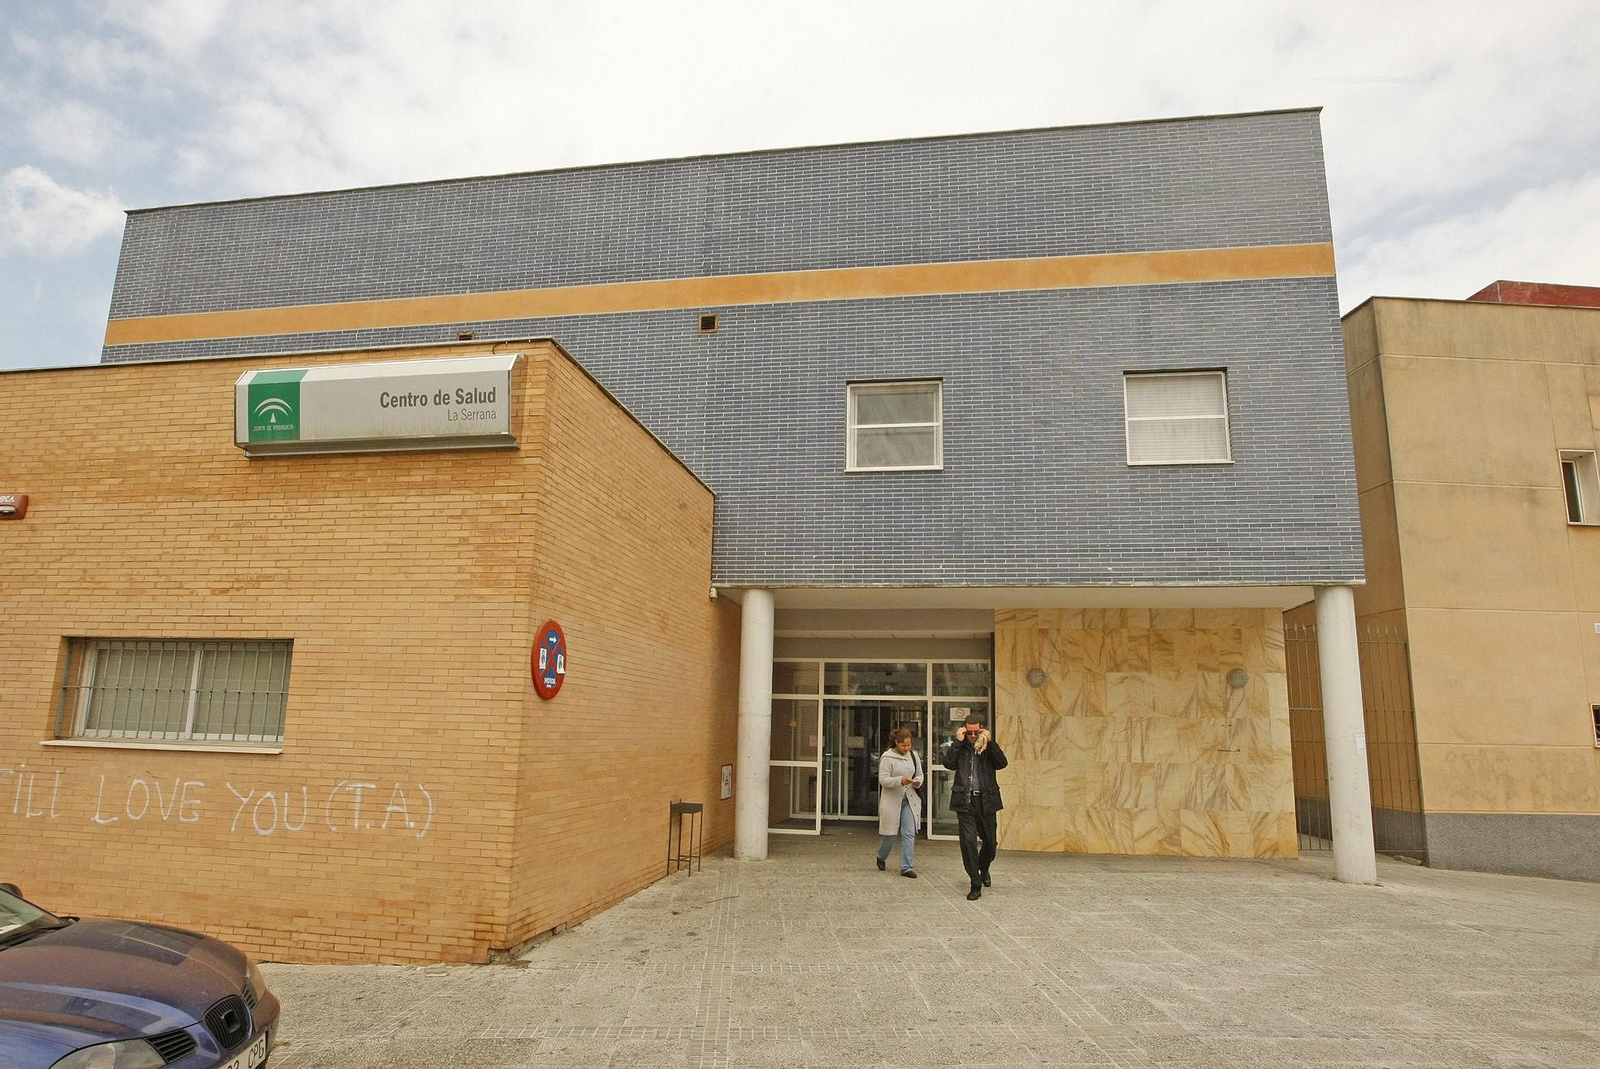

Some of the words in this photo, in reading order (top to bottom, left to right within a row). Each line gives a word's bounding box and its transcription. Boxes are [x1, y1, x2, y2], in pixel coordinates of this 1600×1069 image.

[380, 391, 428, 408] Centro
[433, 389, 450, 406] de
[455, 386, 496, 405] Salud
[447, 409, 458, 421] La
[461, 408, 497, 421] Serrana
[91, 774, 205, 824] LOVE
[226, 781, 308, 836] YOU
[248, 1039, 265, 1068] CPG
